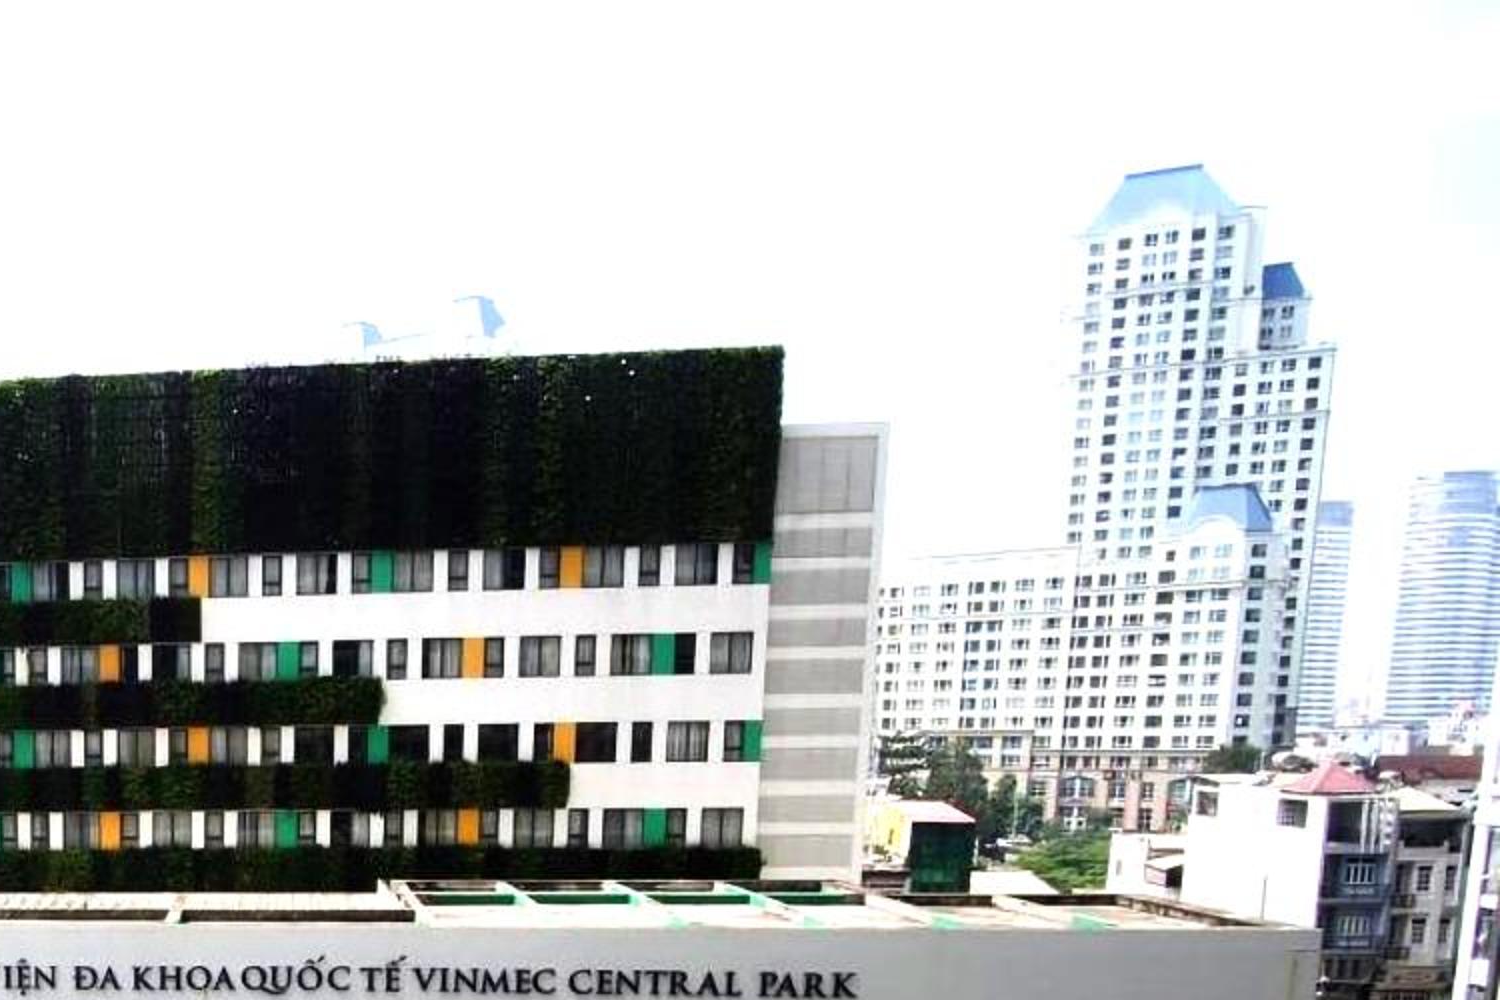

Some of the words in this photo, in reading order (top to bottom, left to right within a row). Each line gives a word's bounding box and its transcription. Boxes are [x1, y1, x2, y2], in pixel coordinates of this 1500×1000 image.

[73, 965, 121, 992] ĐA
[359, 956, 407, 993] TẾ
[414, 967, 557, 996] VINMEC
[567, 967, 743, 999] CENTRAL
[756, 970, 858, 1000] PARK
